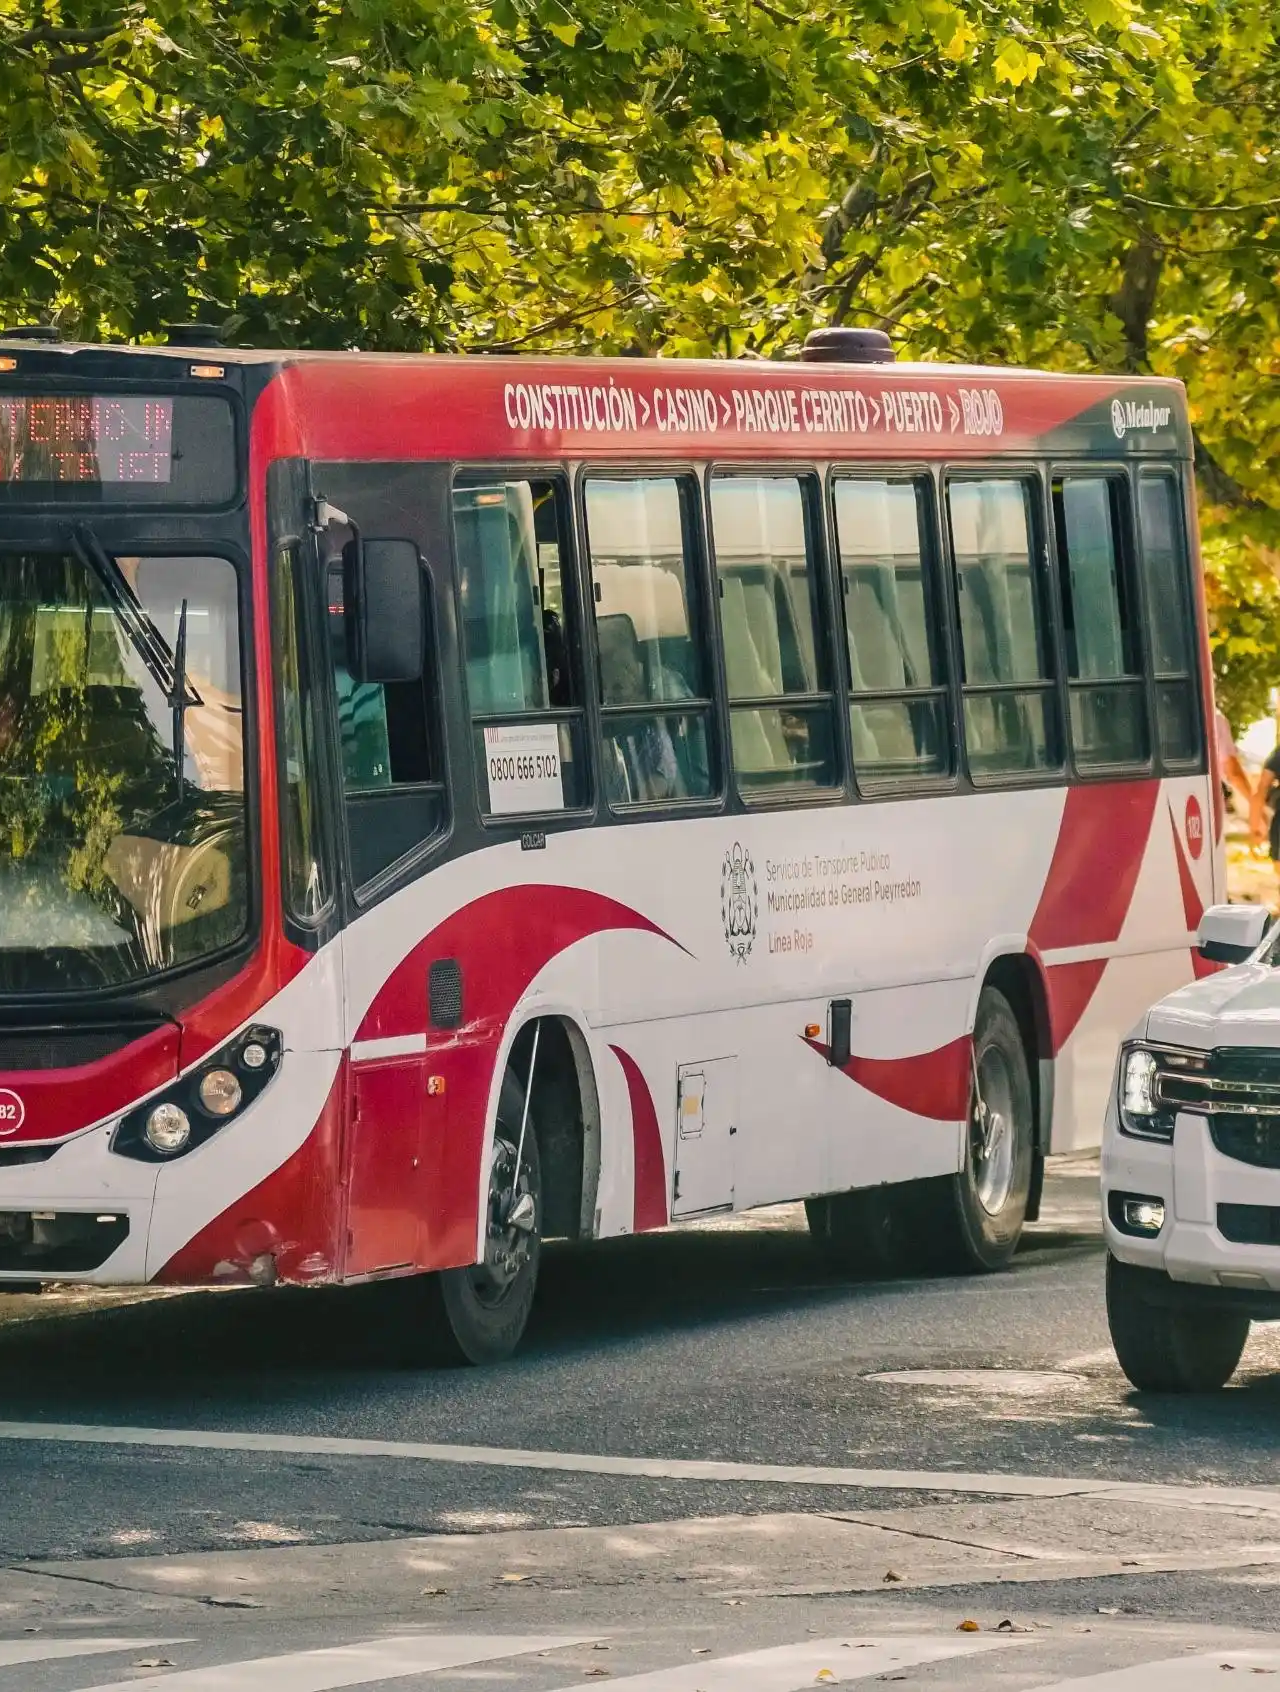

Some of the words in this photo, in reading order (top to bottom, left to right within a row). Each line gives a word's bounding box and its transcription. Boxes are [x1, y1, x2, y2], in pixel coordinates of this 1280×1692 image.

[504, 376, 637, 431] CONSTITUCIÓN
[654, 388, 718, 432] CASINO
[731, 389, 801, 432] PARQUE
[802, 390, 869, 432] CERRITO
[881, 391, 943, 432] PUERTO
[958, 388, 1003, 436] ROJO
[1125, 400, 1170, 434] Metalpar
[490, 757, 515, 781] 0800
[517, 756, 535, 779] 666
[537, 755, 558, 778] 5102
[766, 857, 800, 882] Servicio
[801, 855, 812, 878] de
[815, 855, 859, 879] Transporte
[767, 886, 826, 914] Municipalidad
[829, 884, 838, 906] de
[841, 880, 873, 904] General
[794, 928, 814, 953] Roja
